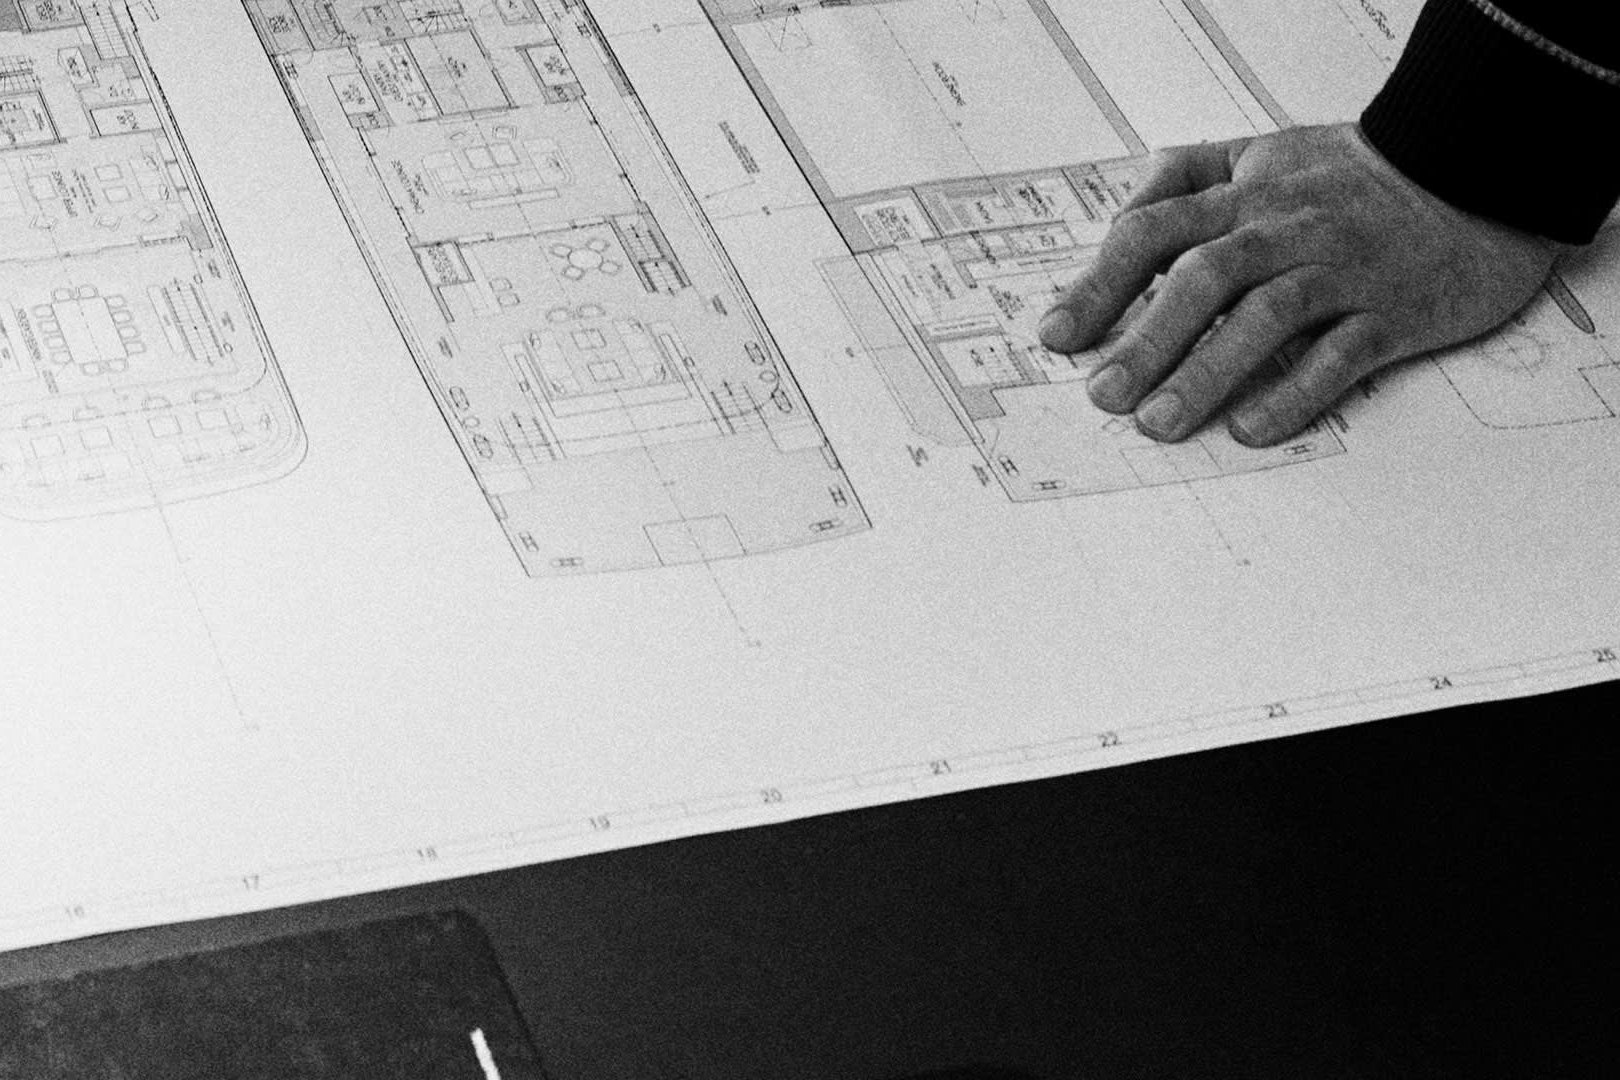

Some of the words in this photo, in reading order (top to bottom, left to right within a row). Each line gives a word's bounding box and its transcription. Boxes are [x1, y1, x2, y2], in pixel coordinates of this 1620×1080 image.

[1593, 647, 1617, 663] 25
[1430, 674, 1453, 690] 24
[1266, 702, 1289, 718] 23
[1099, 731, 1122, 747] 22
[931, 759, 952, 776] 21
[760, 787, 784, 804] 20
[587, 813, 612, 831] 19
[241, 874, 261, 892] 17
